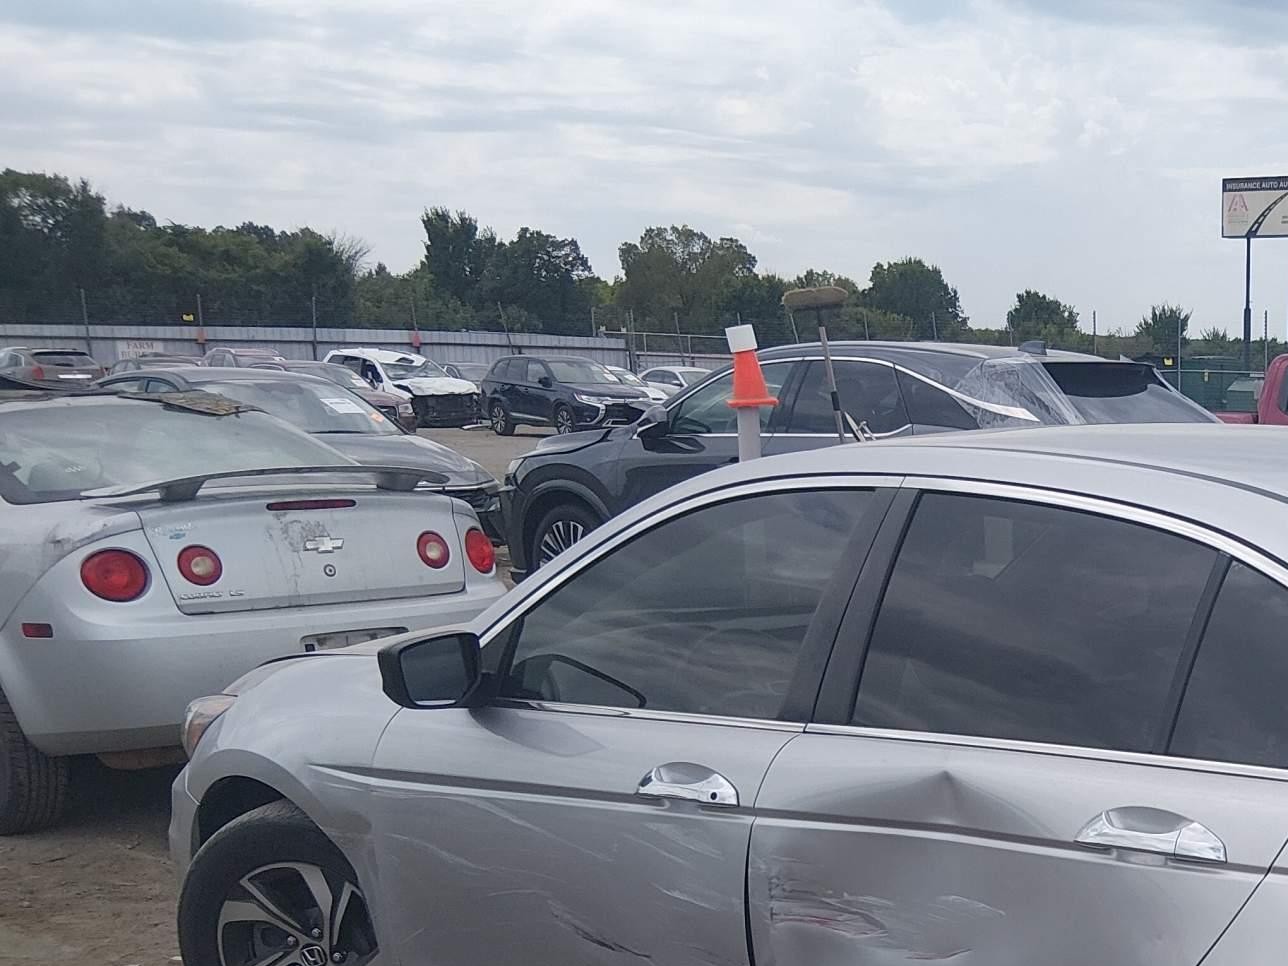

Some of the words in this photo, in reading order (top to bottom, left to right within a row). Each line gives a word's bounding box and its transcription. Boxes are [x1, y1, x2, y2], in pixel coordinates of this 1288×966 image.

[1226, 182, 1260, 190] INSURANCE
[1262, 181, 1278, 189] AUTO
[127, 341, 154, 350] FARM
